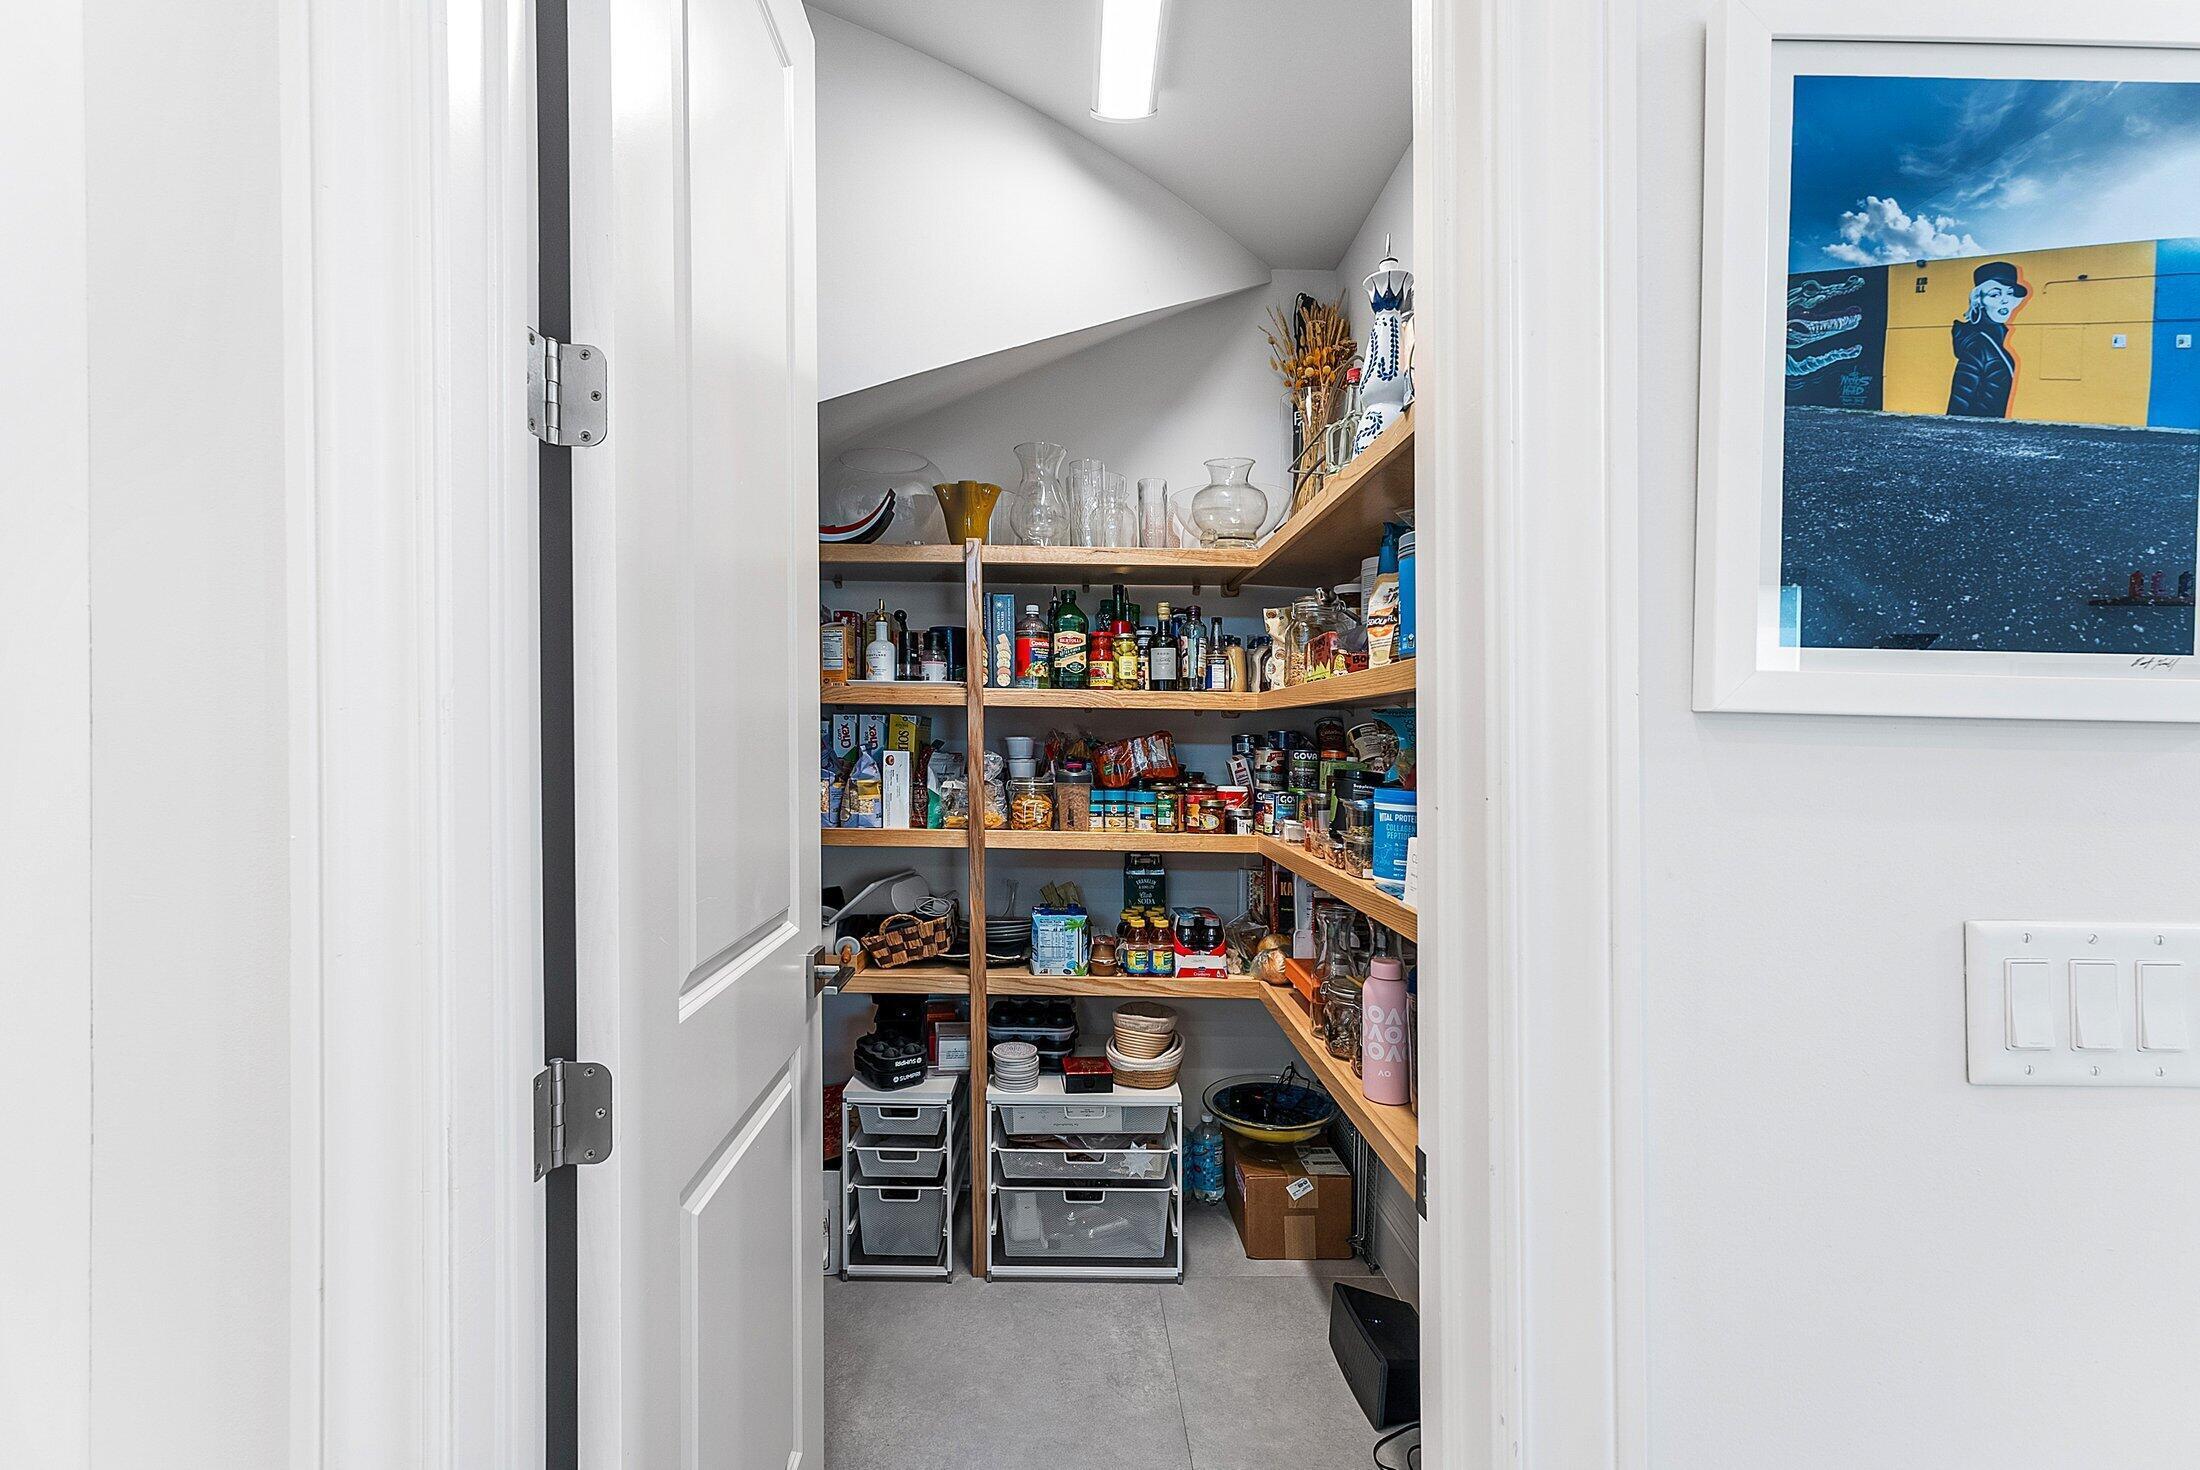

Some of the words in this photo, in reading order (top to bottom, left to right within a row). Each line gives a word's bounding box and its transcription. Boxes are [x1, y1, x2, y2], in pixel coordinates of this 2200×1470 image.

[841, 723, 851, 749] Chex
[1293, 752, 1318, 760] GOYA
[1379, 813, 1394, 822] VITAL
